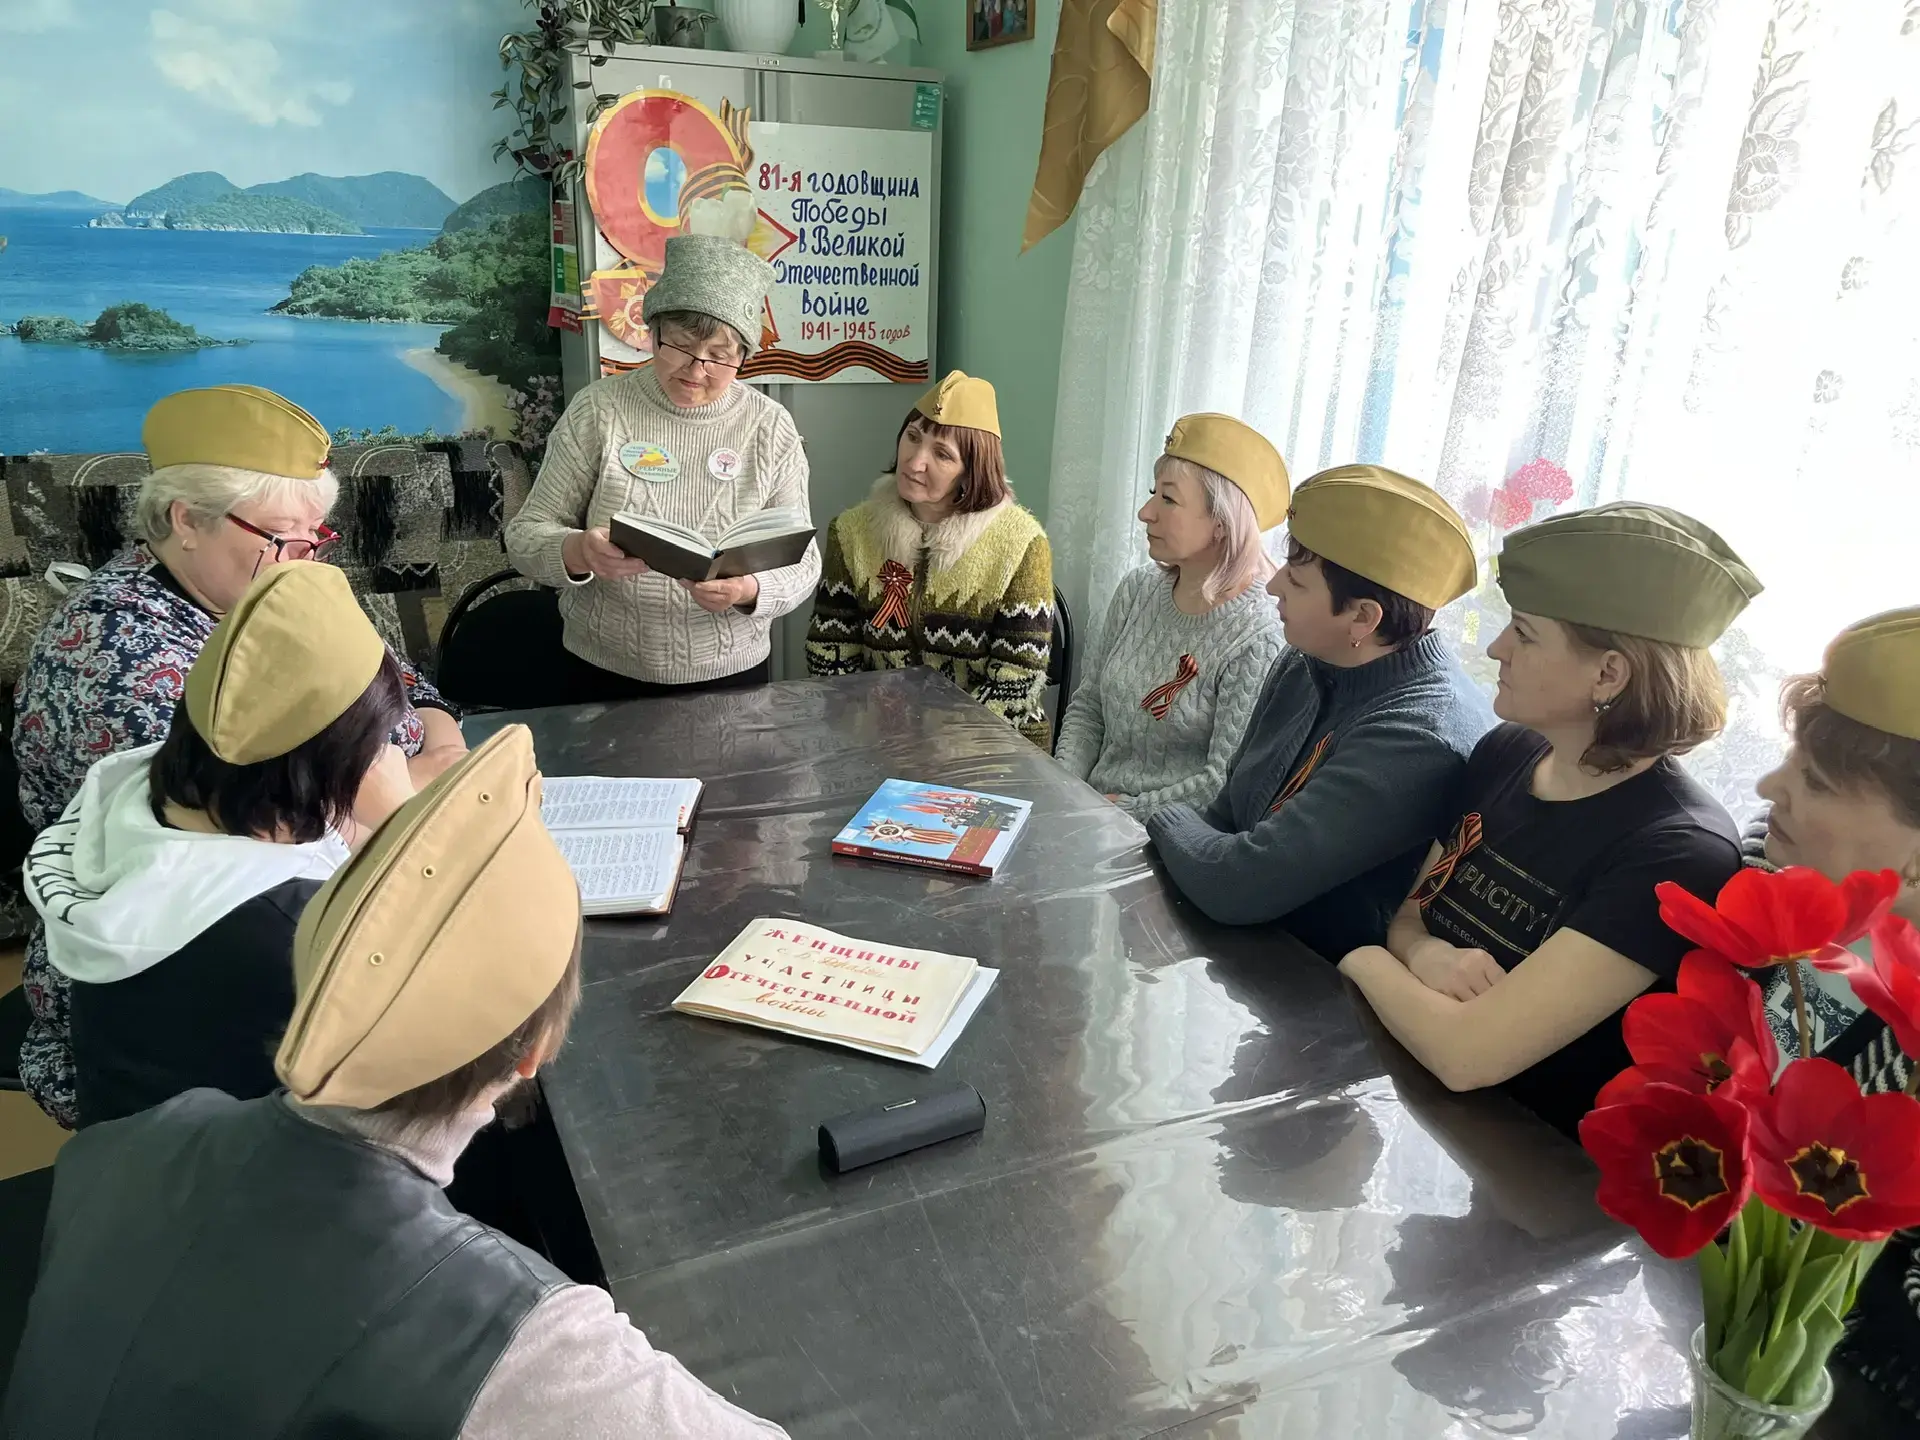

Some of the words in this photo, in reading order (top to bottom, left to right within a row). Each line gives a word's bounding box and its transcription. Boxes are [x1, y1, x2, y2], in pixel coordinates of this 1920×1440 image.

[759, 163, 802, 192] 81-я
[807, 169, 920, 200] годовщина
[791, 198, 887, 233] Победы
[799, 227, 807, 253] в
[811, 225, 905, 258] Великой
[774, 259, 920, 287] Отечественной
[801, 289, 870, 317] войне
[801, 321, 877, 341] 1941-1945
[880, 325, 911, 344] годов
[1454, 861, 1548, 932] PLICITY
[764, 928, 921, 971] ЖЕНЩИНЫ
[1452, 924, 1489, 951] ELEGAN
[703, 964, 917, 1024] ОТЕЧЕСТВЕННОЙ
[743, 954, 921, 1005] УЧАСТНИЦЫ
[755, 993, 828, 1018] войны
[1767, 981, 1841, 1053] LOV
